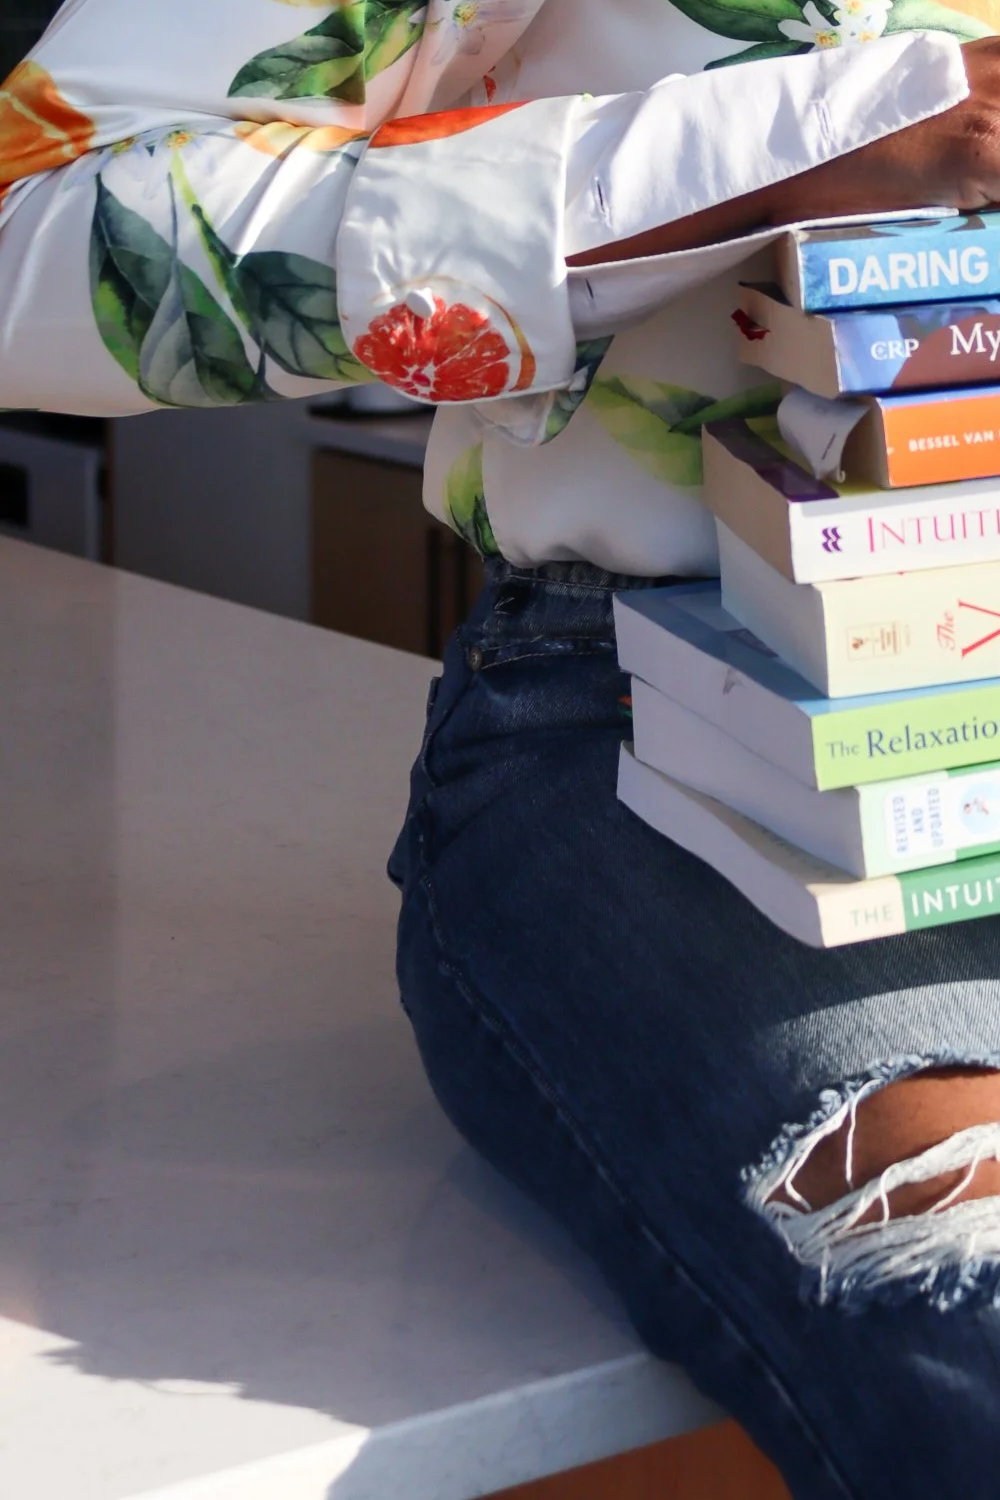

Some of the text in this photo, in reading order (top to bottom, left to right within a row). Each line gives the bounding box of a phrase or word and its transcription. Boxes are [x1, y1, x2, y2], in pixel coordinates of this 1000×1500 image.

[828, 246, 989, 296] DARING
[870, 338, 920, 361] CRP
[908, 436, 959, 452] BESSEL
[963, 430, 994, 445] VAN
[936, 610, 956, 652] The
[826, 740, 860, 759] The
[851, 903, 893, 927] THE
